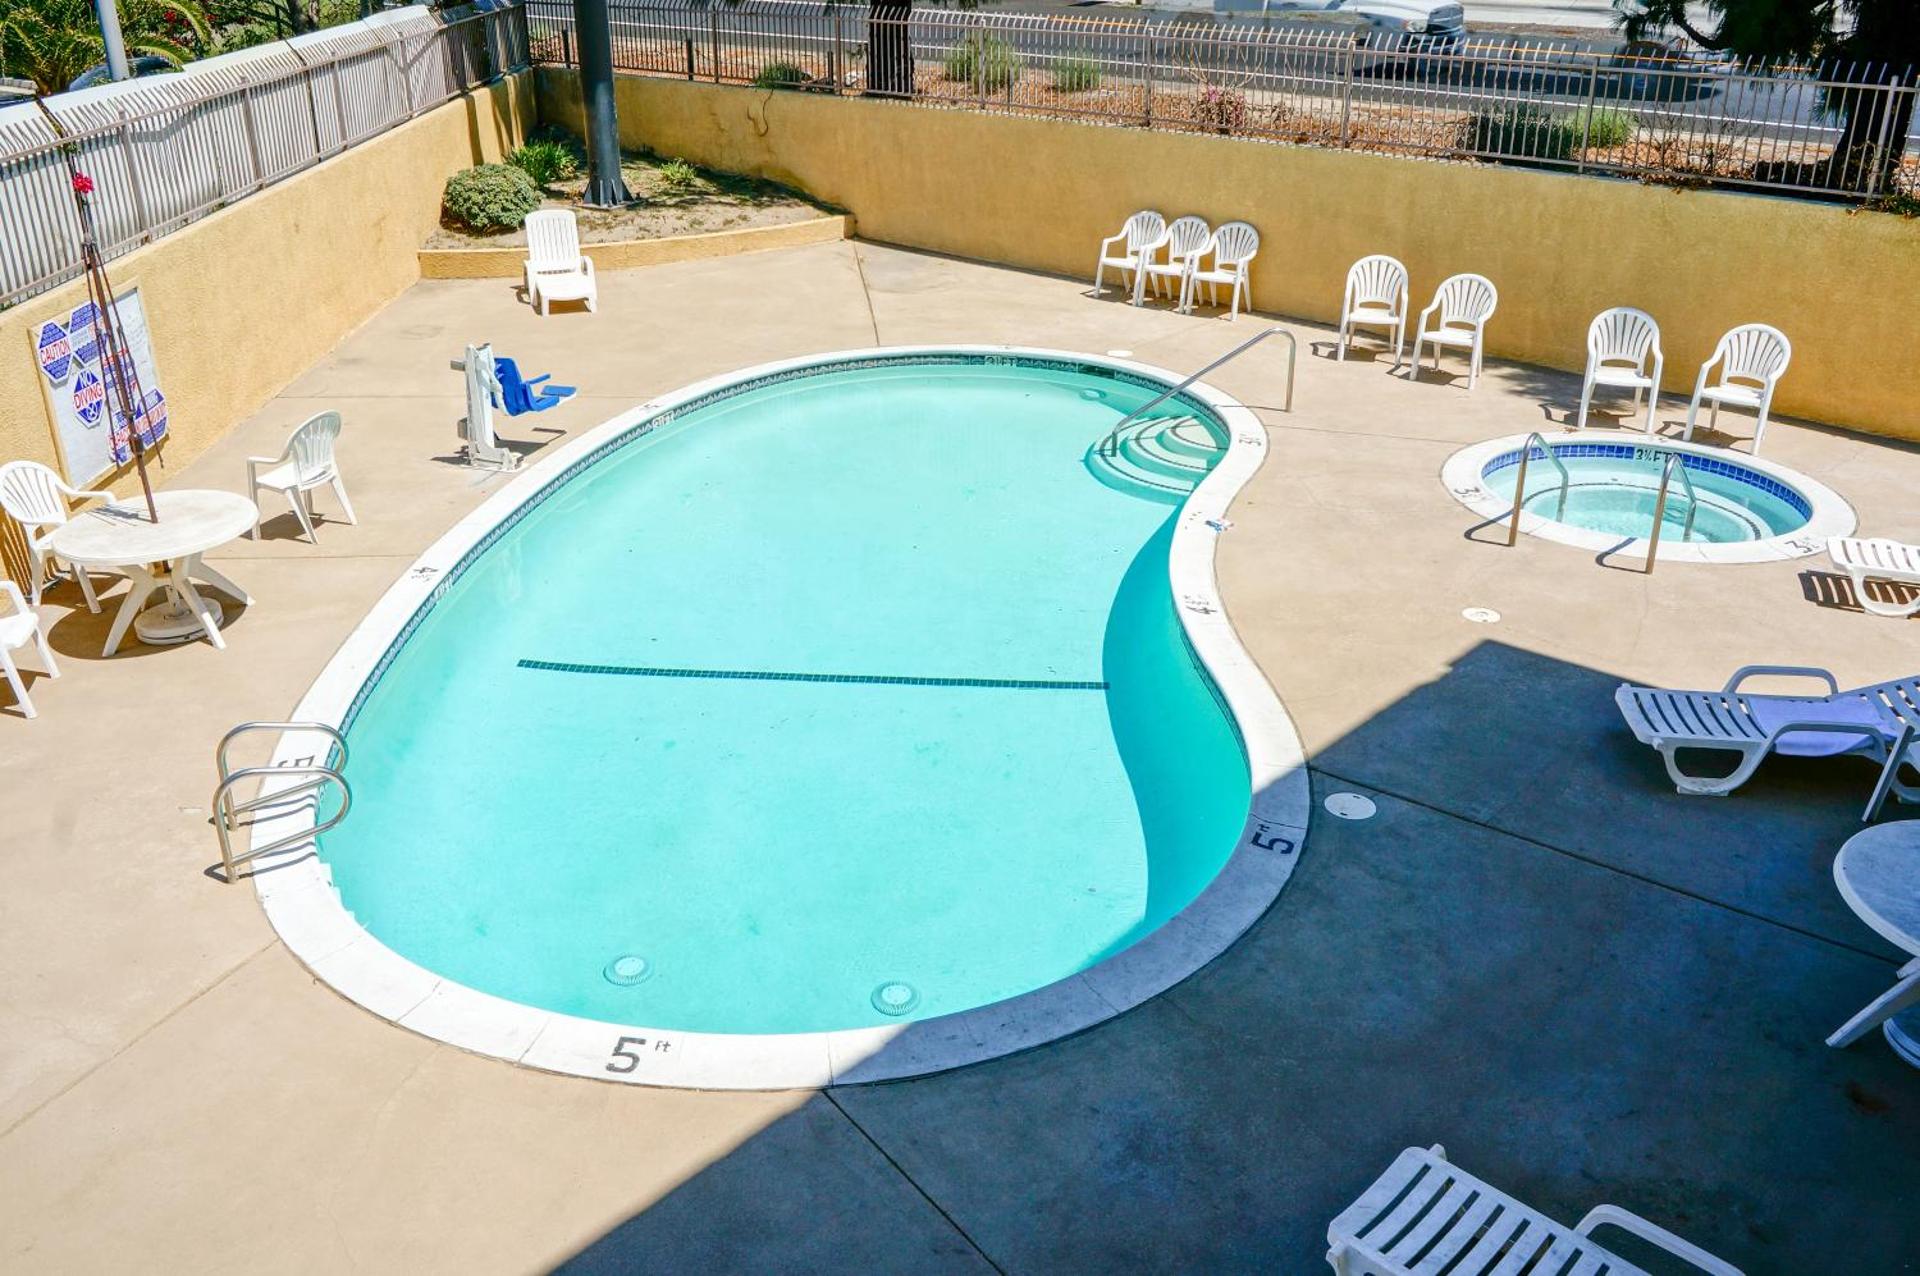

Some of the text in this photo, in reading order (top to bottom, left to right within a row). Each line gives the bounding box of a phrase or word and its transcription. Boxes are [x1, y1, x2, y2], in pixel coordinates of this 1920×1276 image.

[40, 337, 71, 365] CAUTION
[79, 369, 94, 389] NO
[73, 382, 103, 409] DIVING
[1250, 831, 1295, 855] 5
[605, 1036, 647, 1073] 5
